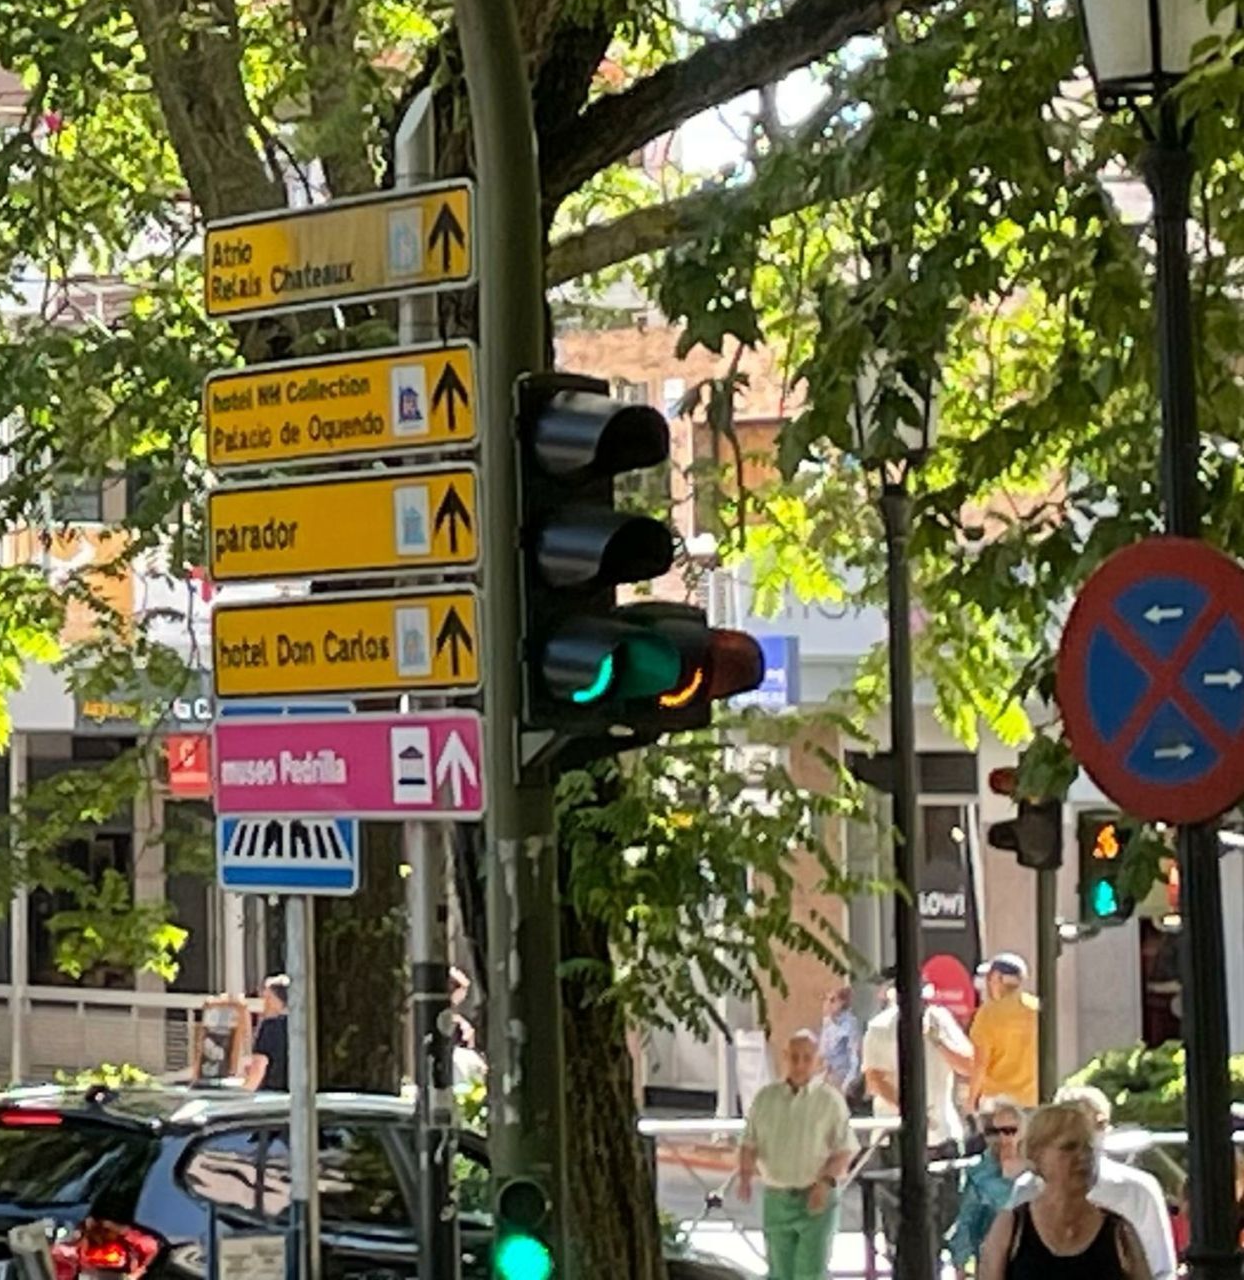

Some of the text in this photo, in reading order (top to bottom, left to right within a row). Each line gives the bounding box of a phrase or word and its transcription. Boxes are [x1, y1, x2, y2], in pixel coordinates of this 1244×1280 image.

[212, 240, 253, 269] Atrio
[211, 272, 262, 302] Relais
[213, 375, 371, 413] hotel NH Collection
[212, 412, 385, 455] Palacio de Oquendo
[216, 517, 298, 562] parador
[220, 630, 390, 668] hotel Don Carlos
[221, 759, 276, 785] museo
